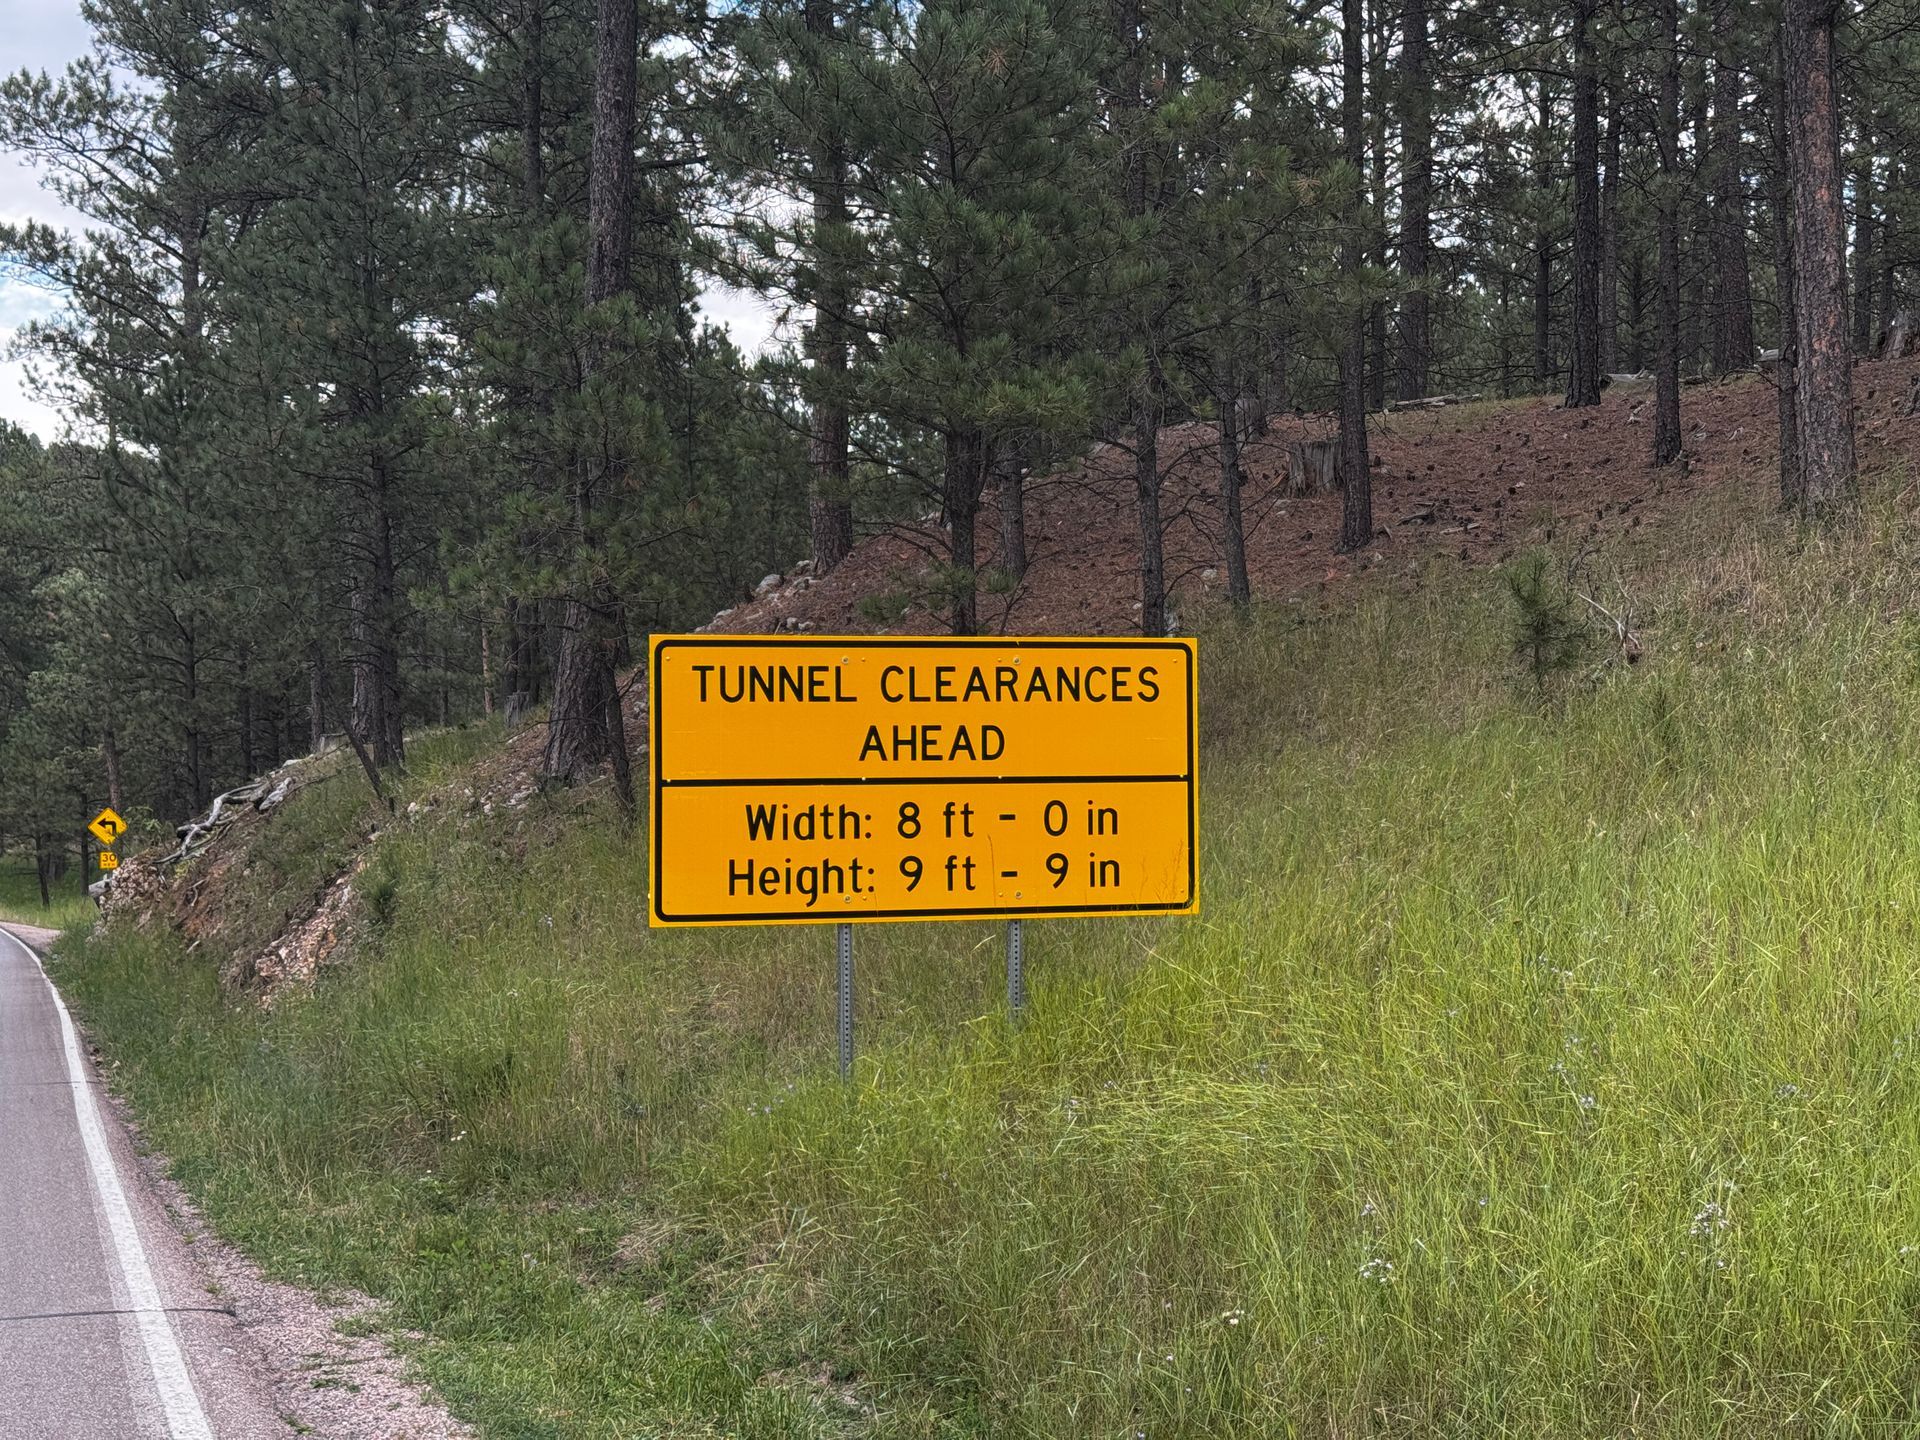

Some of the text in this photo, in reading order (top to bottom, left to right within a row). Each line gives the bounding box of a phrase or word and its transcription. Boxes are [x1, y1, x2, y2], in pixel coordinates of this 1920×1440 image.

[692, 666, 1159, 702] TUNNEL CLEARANCES
[859, 725, 1004, 761] AHEAD
[746, 804, 871, 840] Width:
[898, 802, 920, 838] 8
[944, 802, 974, 837] ft
[1044, 800, 1067, 836] 0
[1088, 801, 1117, 835] in
[102, 853, 116, 862] 30
[729, 858, 874, 907] Height:
[900, 856, 922, 892] 9
[945, 856, 975, 891] ft
[1046, 853, 1068, 888] 9
[1090, 854, 1119, 887] in
